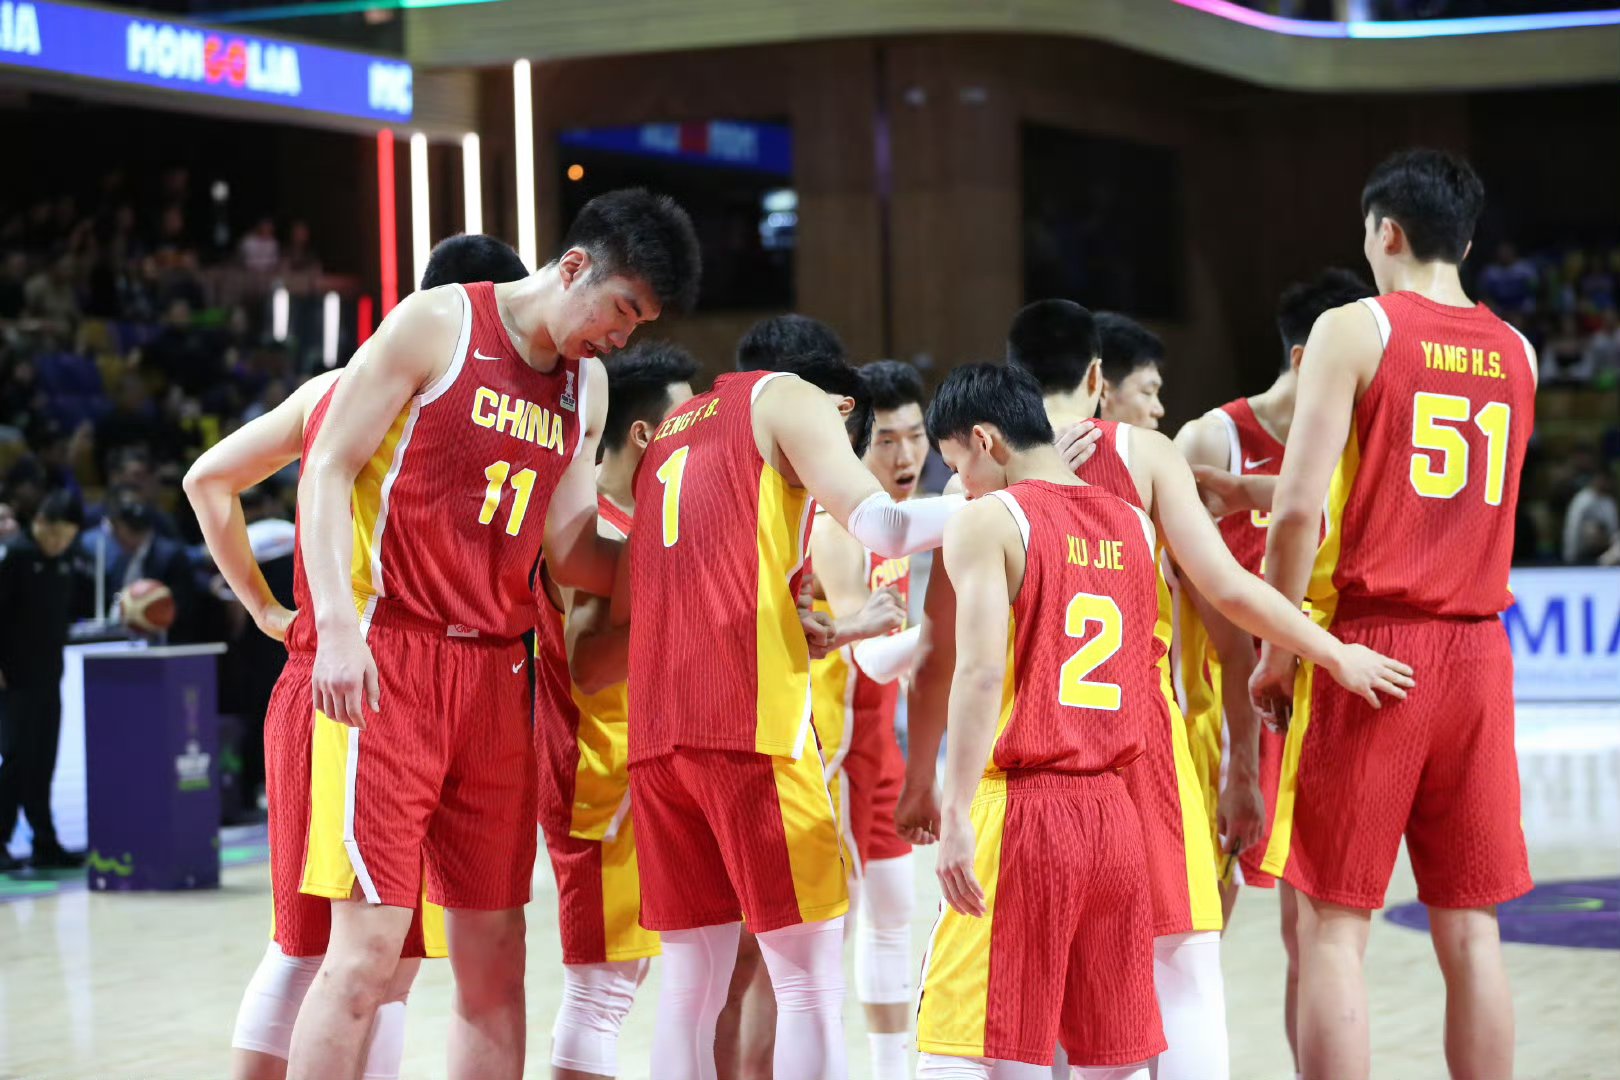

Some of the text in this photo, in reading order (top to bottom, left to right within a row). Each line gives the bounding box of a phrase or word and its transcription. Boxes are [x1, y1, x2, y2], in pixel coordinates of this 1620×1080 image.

[126, 20, 301, 97] MONGOLIA
[1421, 341, 1506, 379] YANG H.S.
[471, 386, 564, 456] CHINA
[1410, 391, 1511, 506] 51
[478, 460, 537, 537] 11
[656, 445, 690, 548] 1
[1066, 534, 1124, 571] XU JIE
[1058, 592, 1123, 711] 2
